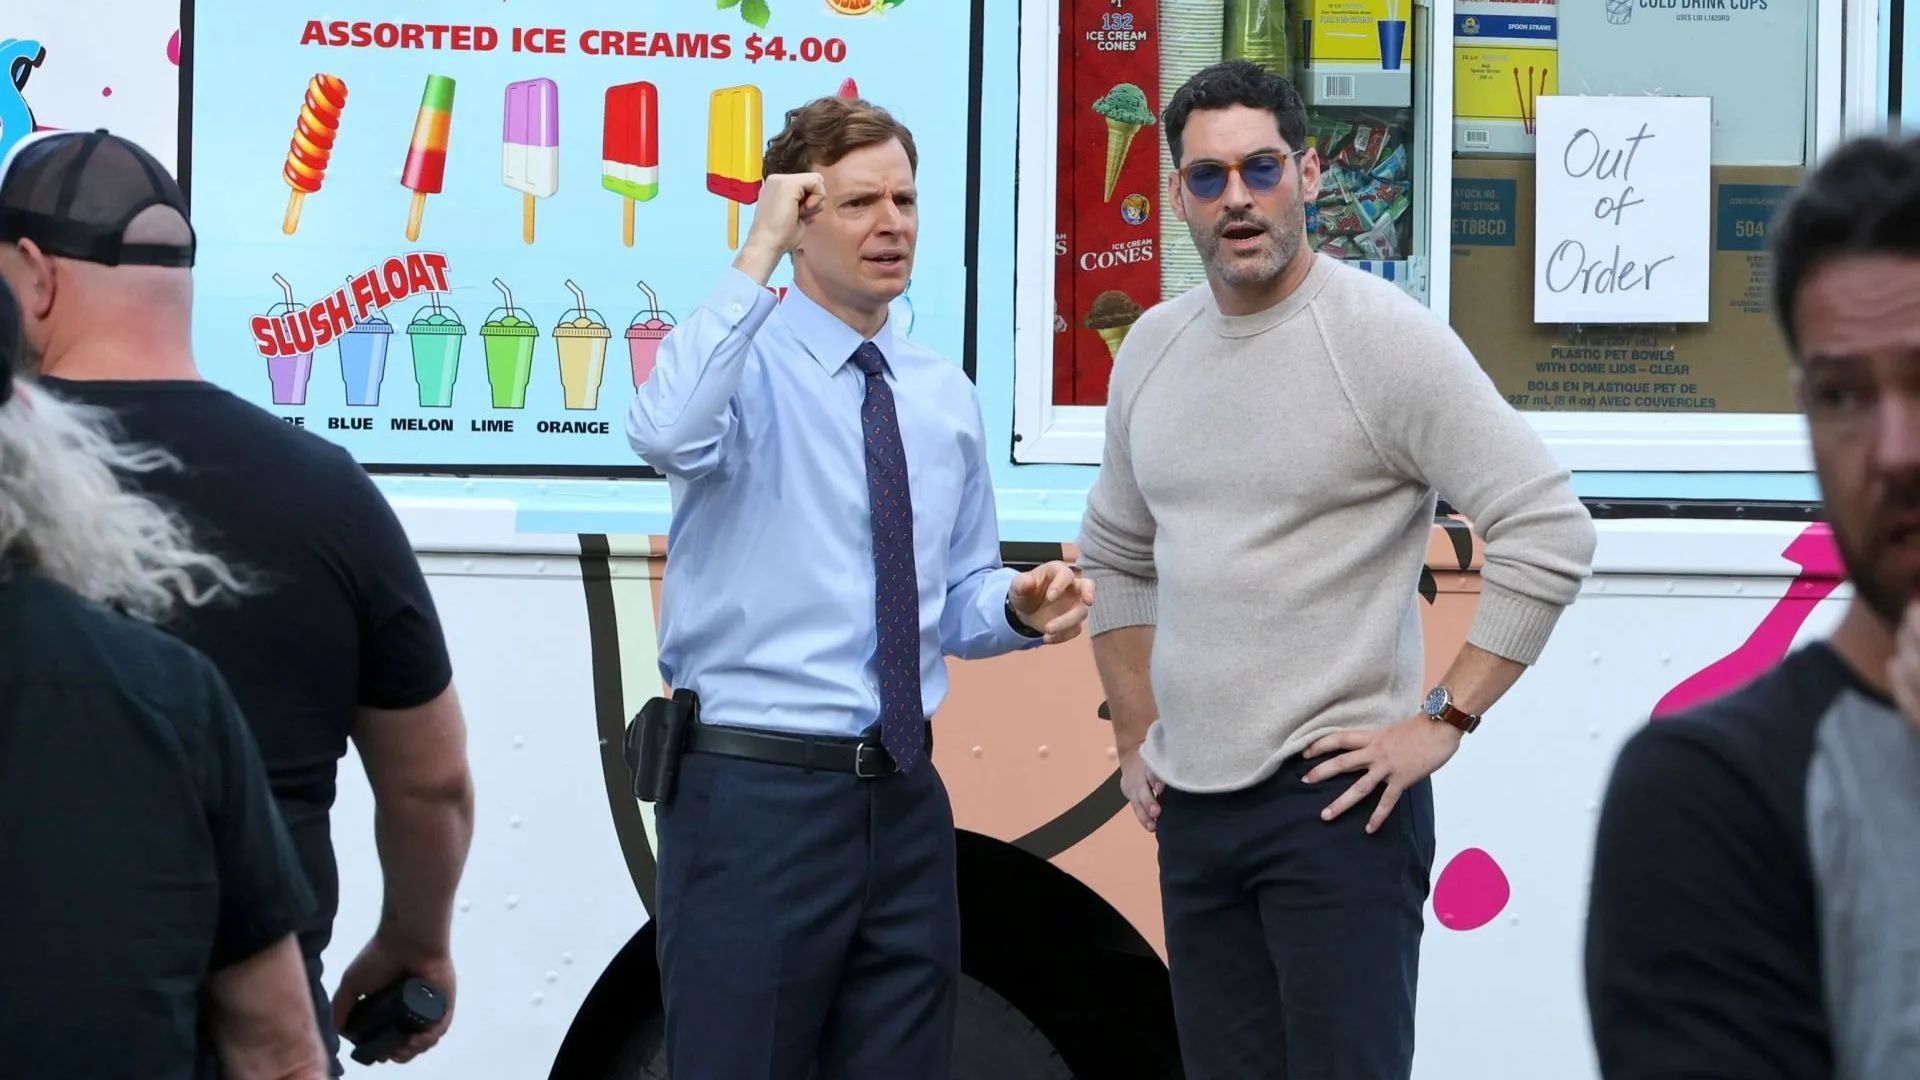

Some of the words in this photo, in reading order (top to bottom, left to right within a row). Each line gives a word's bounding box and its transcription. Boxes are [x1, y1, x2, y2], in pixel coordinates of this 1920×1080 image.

[1639, 0, 1677, 9] COLD
[1681, 0, 1726, 9] DRINK
[1730, 0, 1768, 10] CUPS
[1102, 12, 1134, 31] 132
[1508, 23, 1528, 31] SPOON
[300, 20, 498, 51] ASSORTED
[512, 27, 566, 54] ICE
[579, 29, 731, 59] CREAMS
[745, 33, 847, 64] $4.00
[1086, 31, 1104, 40] ICE
[1107, 31, 1147, 41] CREAM
[1097, 41, 1136, 51] CONES
[1564, 123, 1655, 181] Out
[1594, 186, 1644, 226] of
[1112, 242, 1125, 250] ICE
[1126, 238, 1153, 250] CREAM
[1080, 245, 1153, 271] CONES
[1546, 239, 1675, 294] Order
[250, 286, 356, 358] SLUSH
[349, 251, 451, 321] FLOAT
[1552, 348, 1601, 360] PLASTIC
[1605, 350, 1627, 360] PET
[1631, 350, 1675, 361] BOWLS
[1536, 363, 1566, 373] WITH
[1570, 363, 1605, 374] DOME
[1609, 364, 1636, 374] LIDS
[1650, 365, 1690, 375] CLEAR
[1527, 381, 1559, 391] BOLS
[1563, 381, 1580, 391] EN
[1583, 382, 1650, 393] PLASTIQUE
[1653, 383, 1676, 393] PET
[1680, 384, 1697, 394] DE
[1599, 396, 1631, 406] AVEC
[1634, 397, 1716, 408] COUVERCLES
[328, 417, 373, 430] BLUE
[390, 418, 454, 431] MELON
[471, 419, 514, 432] LIME
[536, 421, 610, 434] ORANGE
